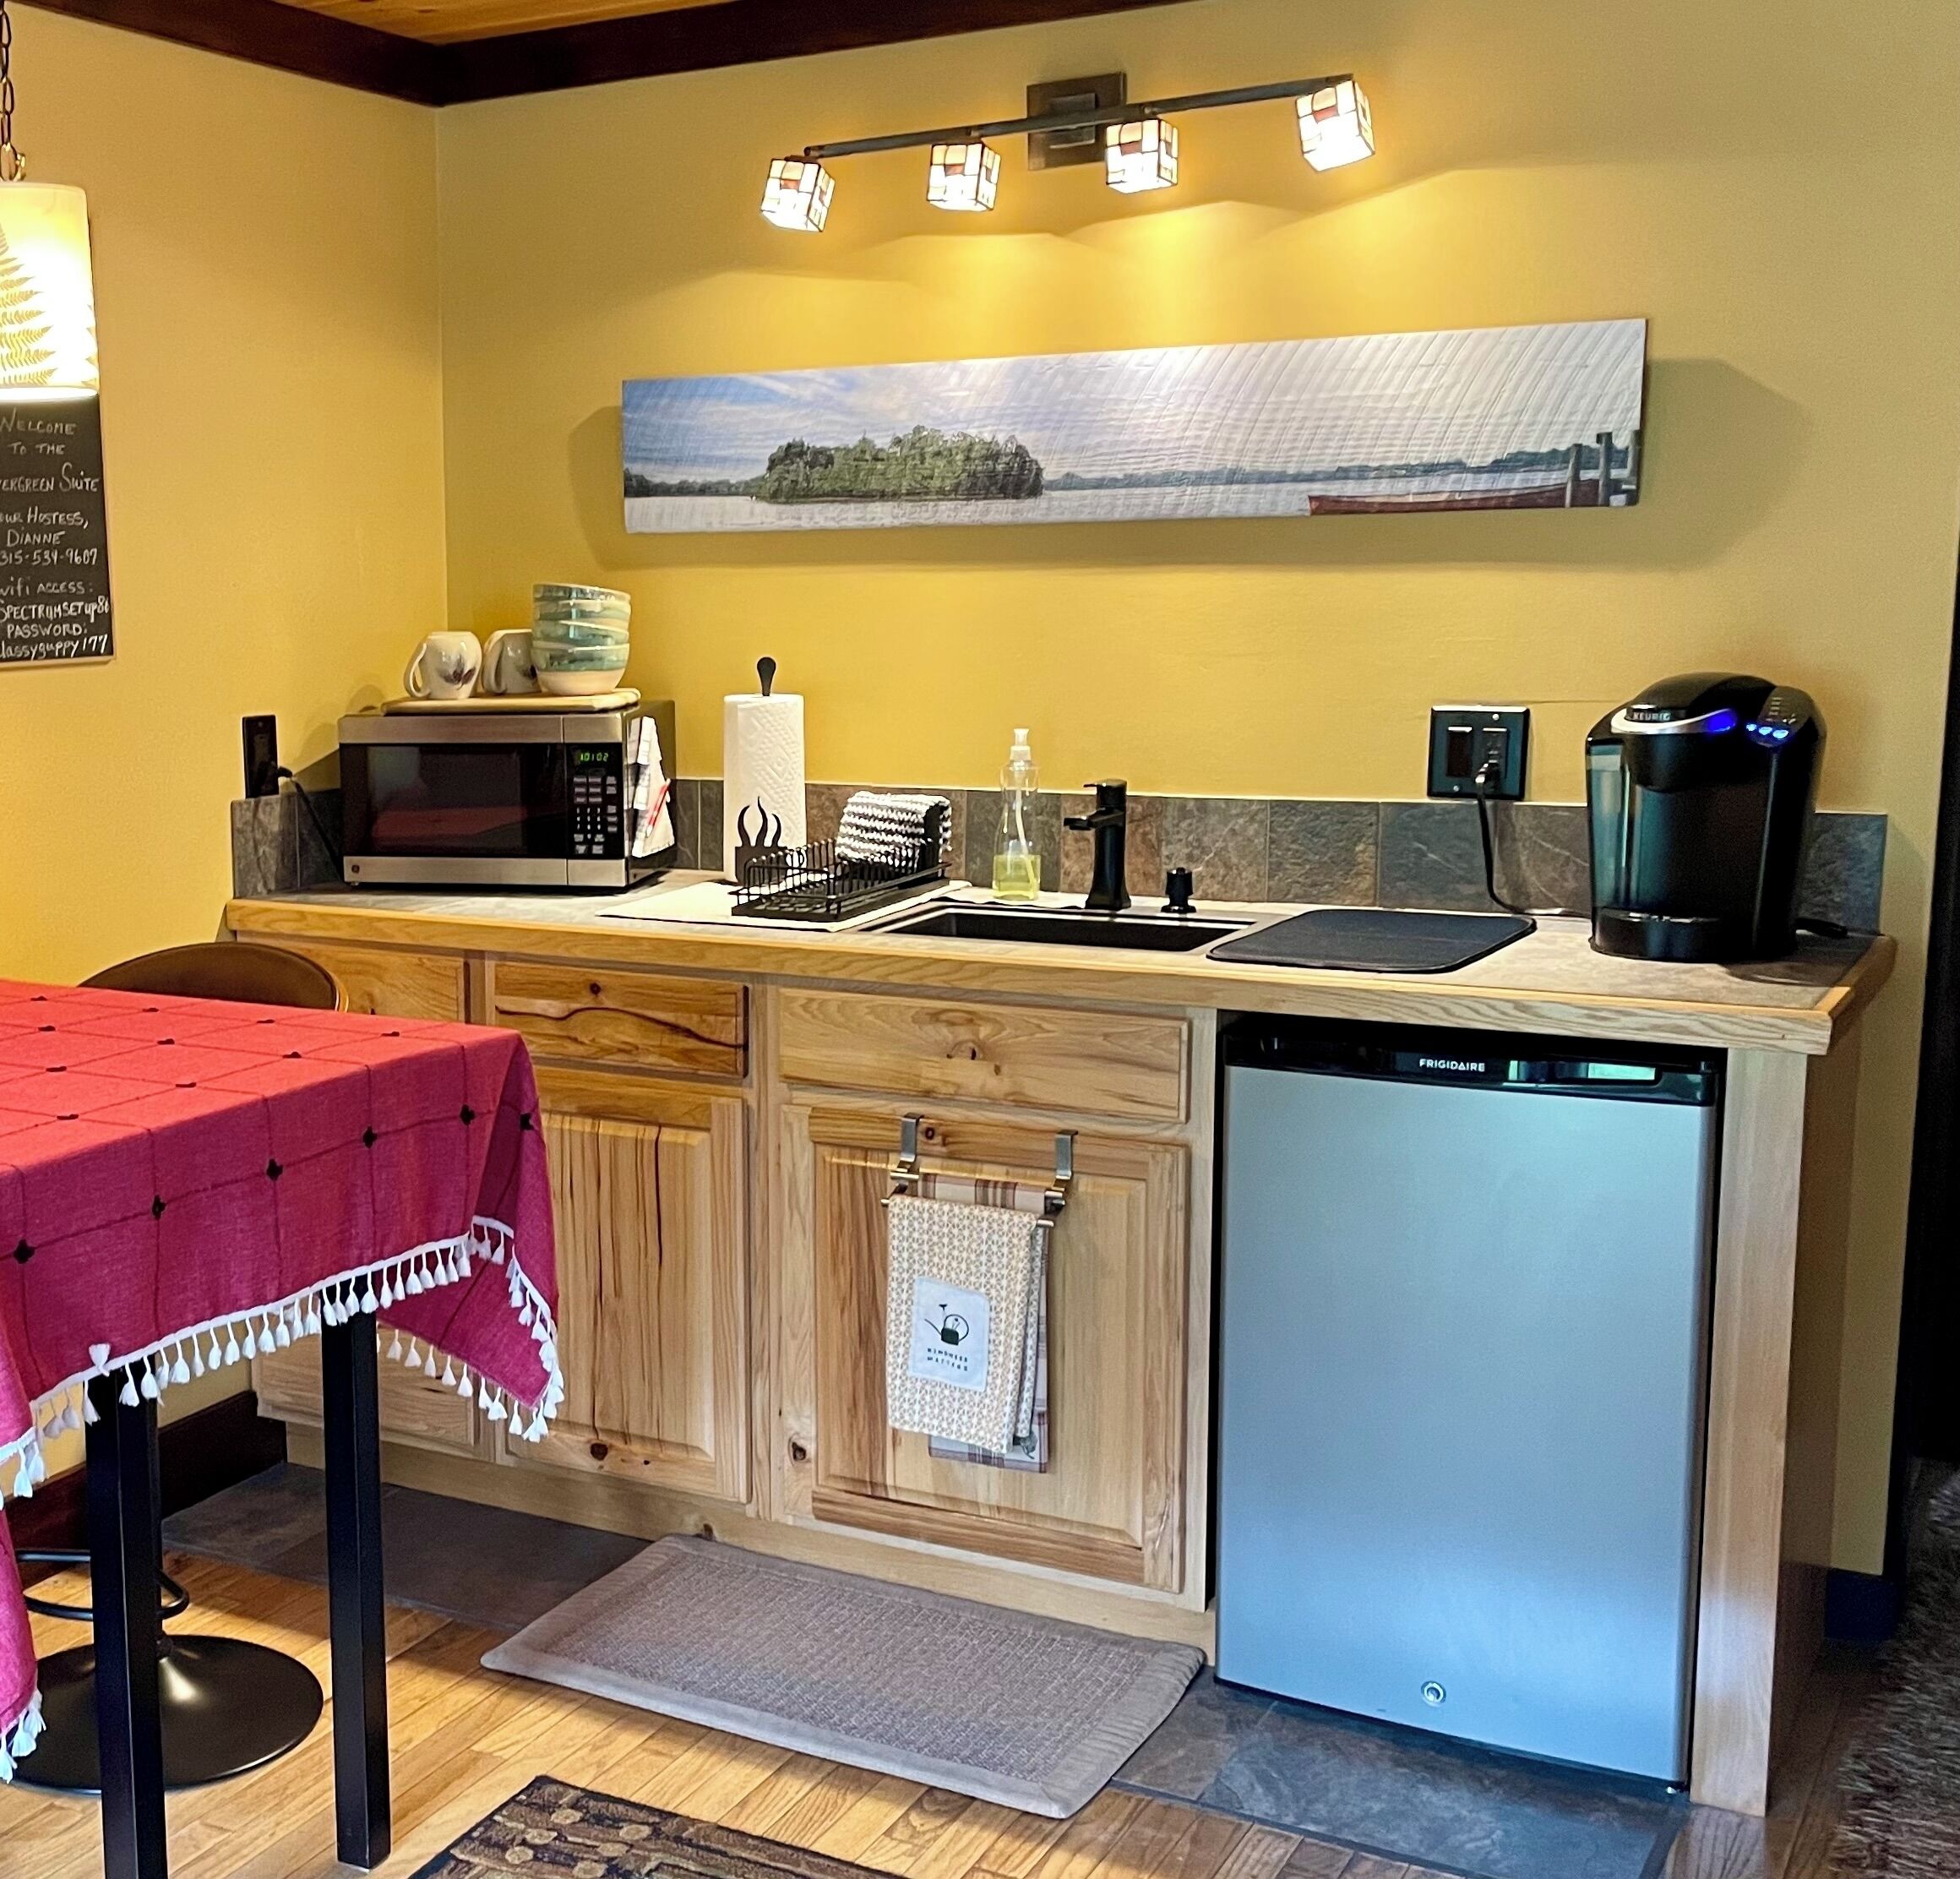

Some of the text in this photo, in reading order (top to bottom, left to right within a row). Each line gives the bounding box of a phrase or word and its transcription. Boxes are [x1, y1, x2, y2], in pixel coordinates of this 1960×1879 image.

[0, 406, 76, 434] WELCOME
[8, 441, 66, 455] TO THE
[0, 476, 55, 493] ERGREEN
[0, 634, 108, 661] lassyguppy177
[1419, 1058, 1485, 1072] FRIGIDAIRE
